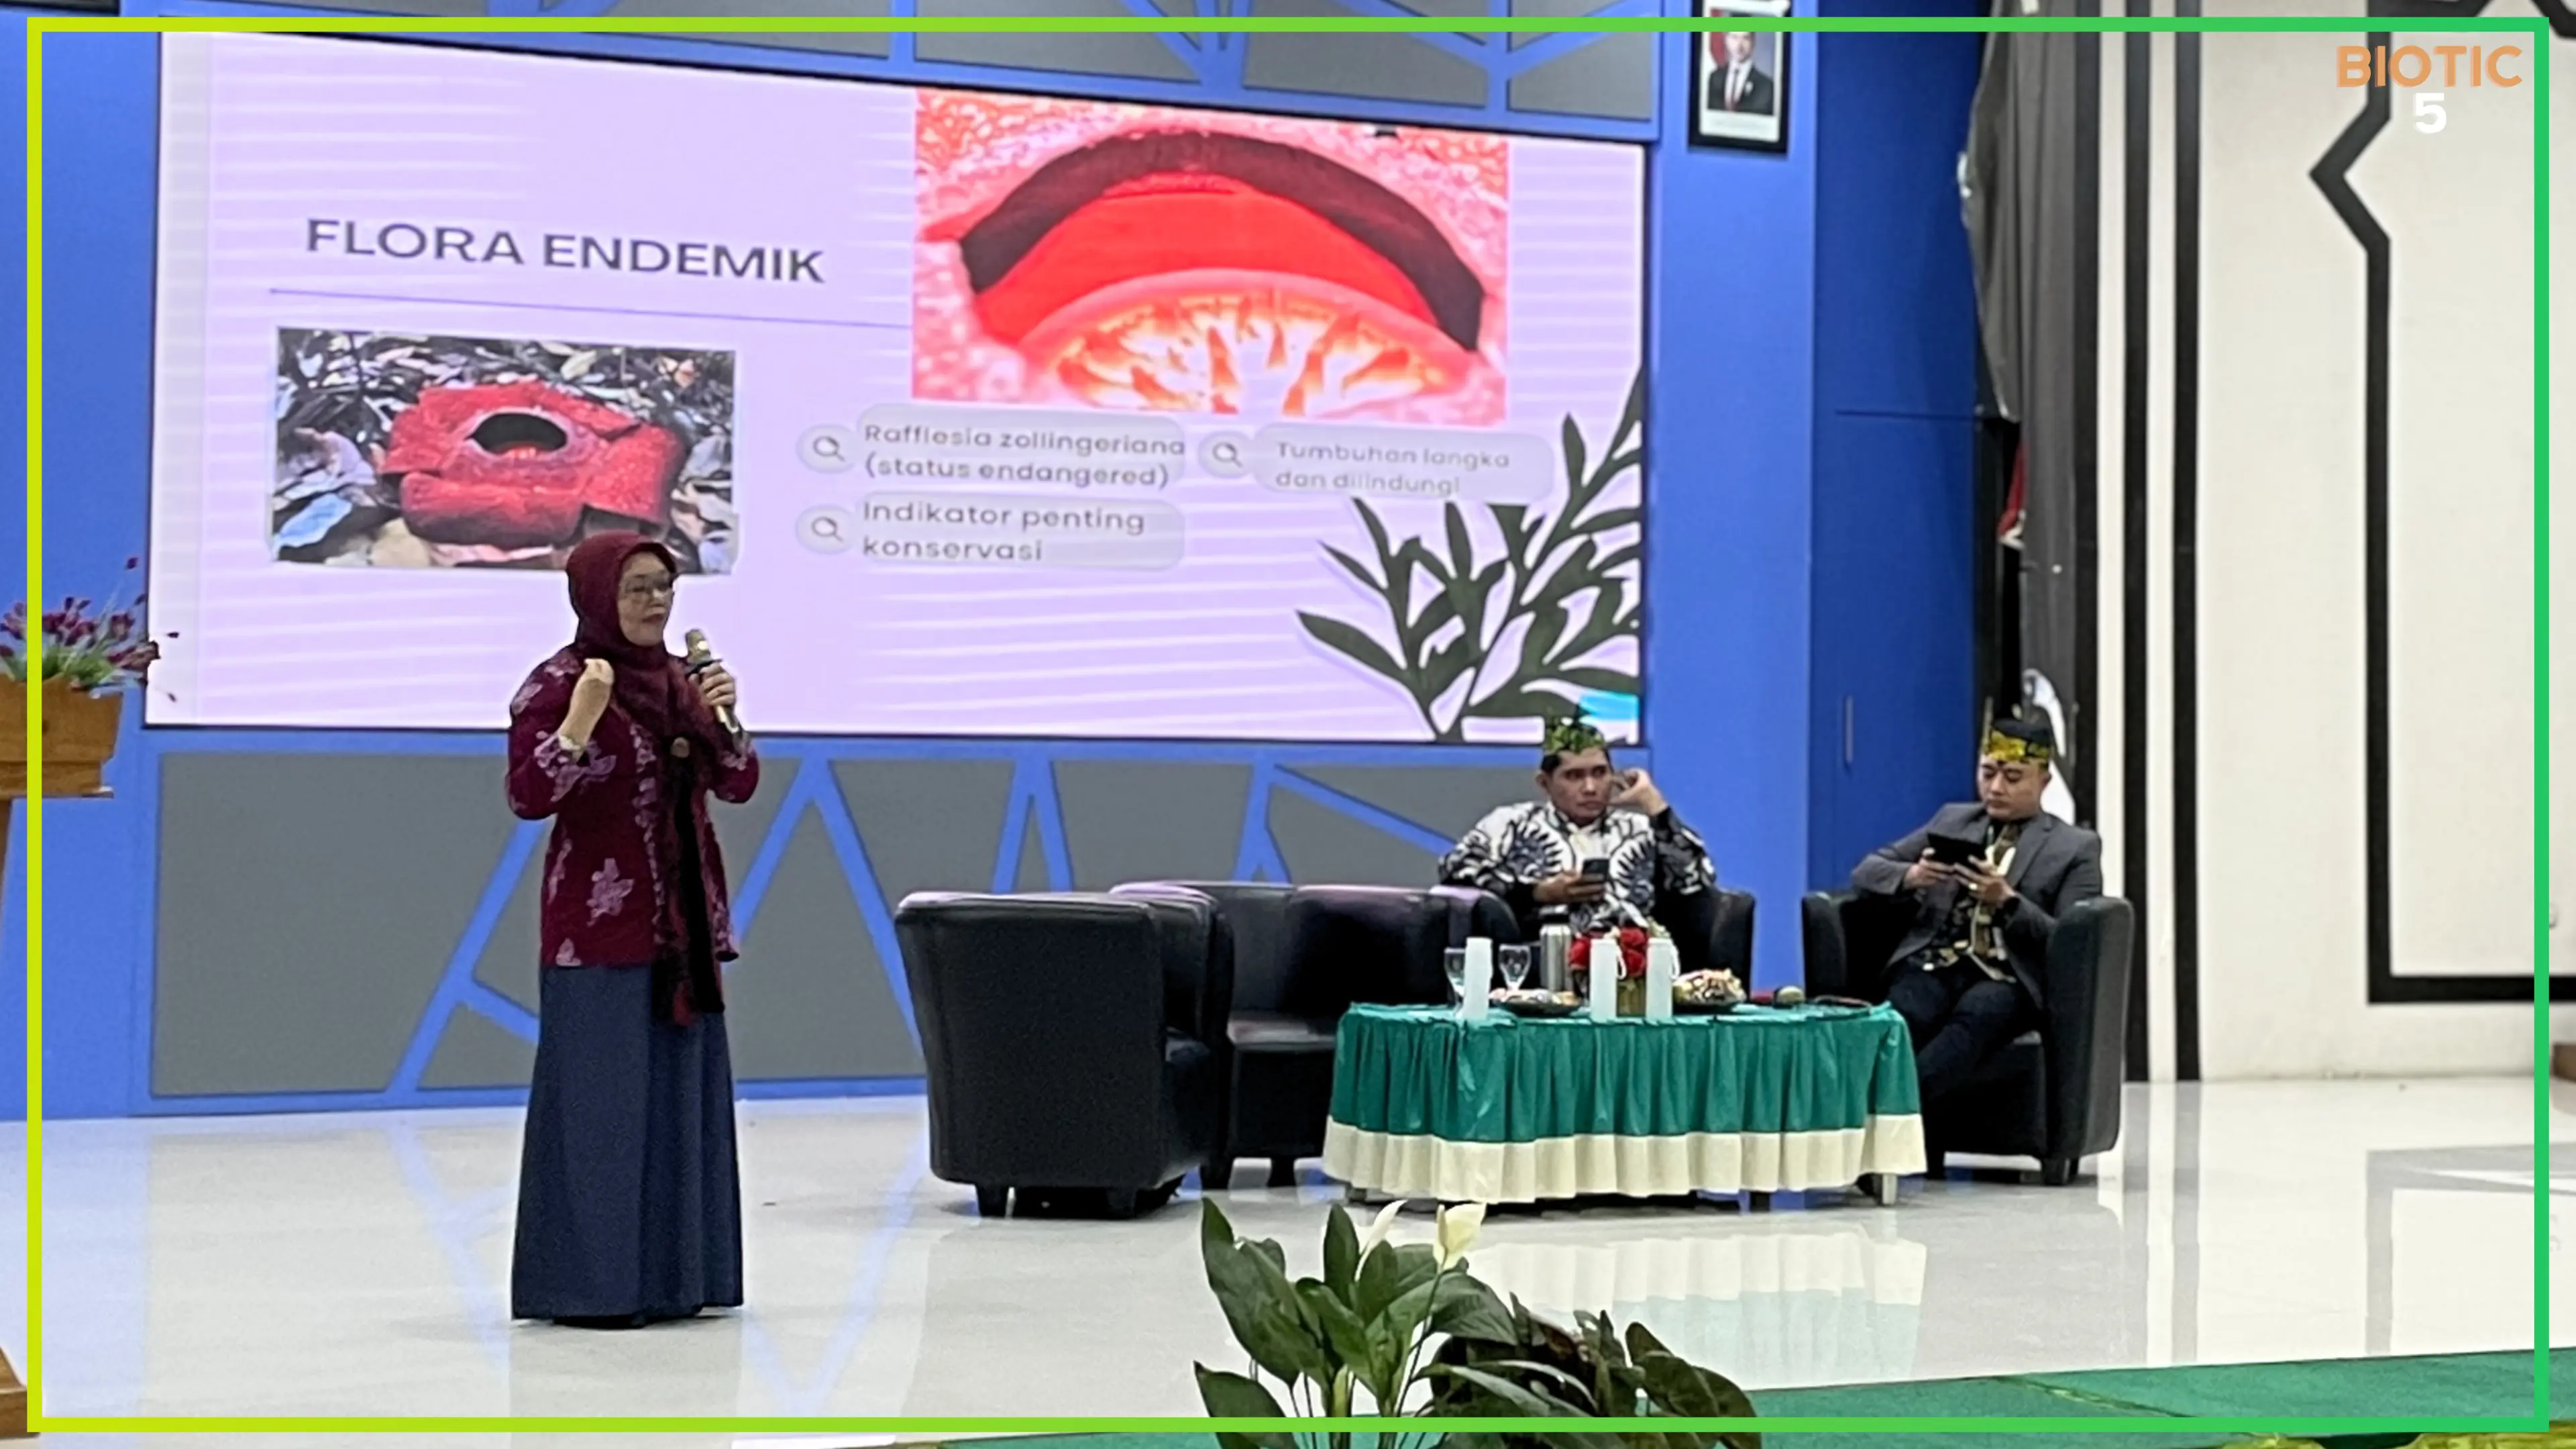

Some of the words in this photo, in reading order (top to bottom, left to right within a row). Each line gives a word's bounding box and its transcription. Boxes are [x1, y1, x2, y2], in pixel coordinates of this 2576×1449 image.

[307, 218, 525, 265] FLORA
[543, 233, 825, 283] ENDEMIK
[865, 424, 992, 447] Rafflesia
[1000, 431, 1186, 457] zollingeriana
[1277, 441, 1417, 464] Tumbuhan
[1424, 446, 1510, 472] langka
[865, 451, 971, 480] (status
[979, 461, 1170, 490] endangered)
[1275, 470, 1326, 489] dan
[1332, 472, 1460, 497] dilindungi
[863, 501, 1011, 527] Indikator
[1020, 505, 1145, 536] penting
[863, 536, 1043, 562] konservasi
